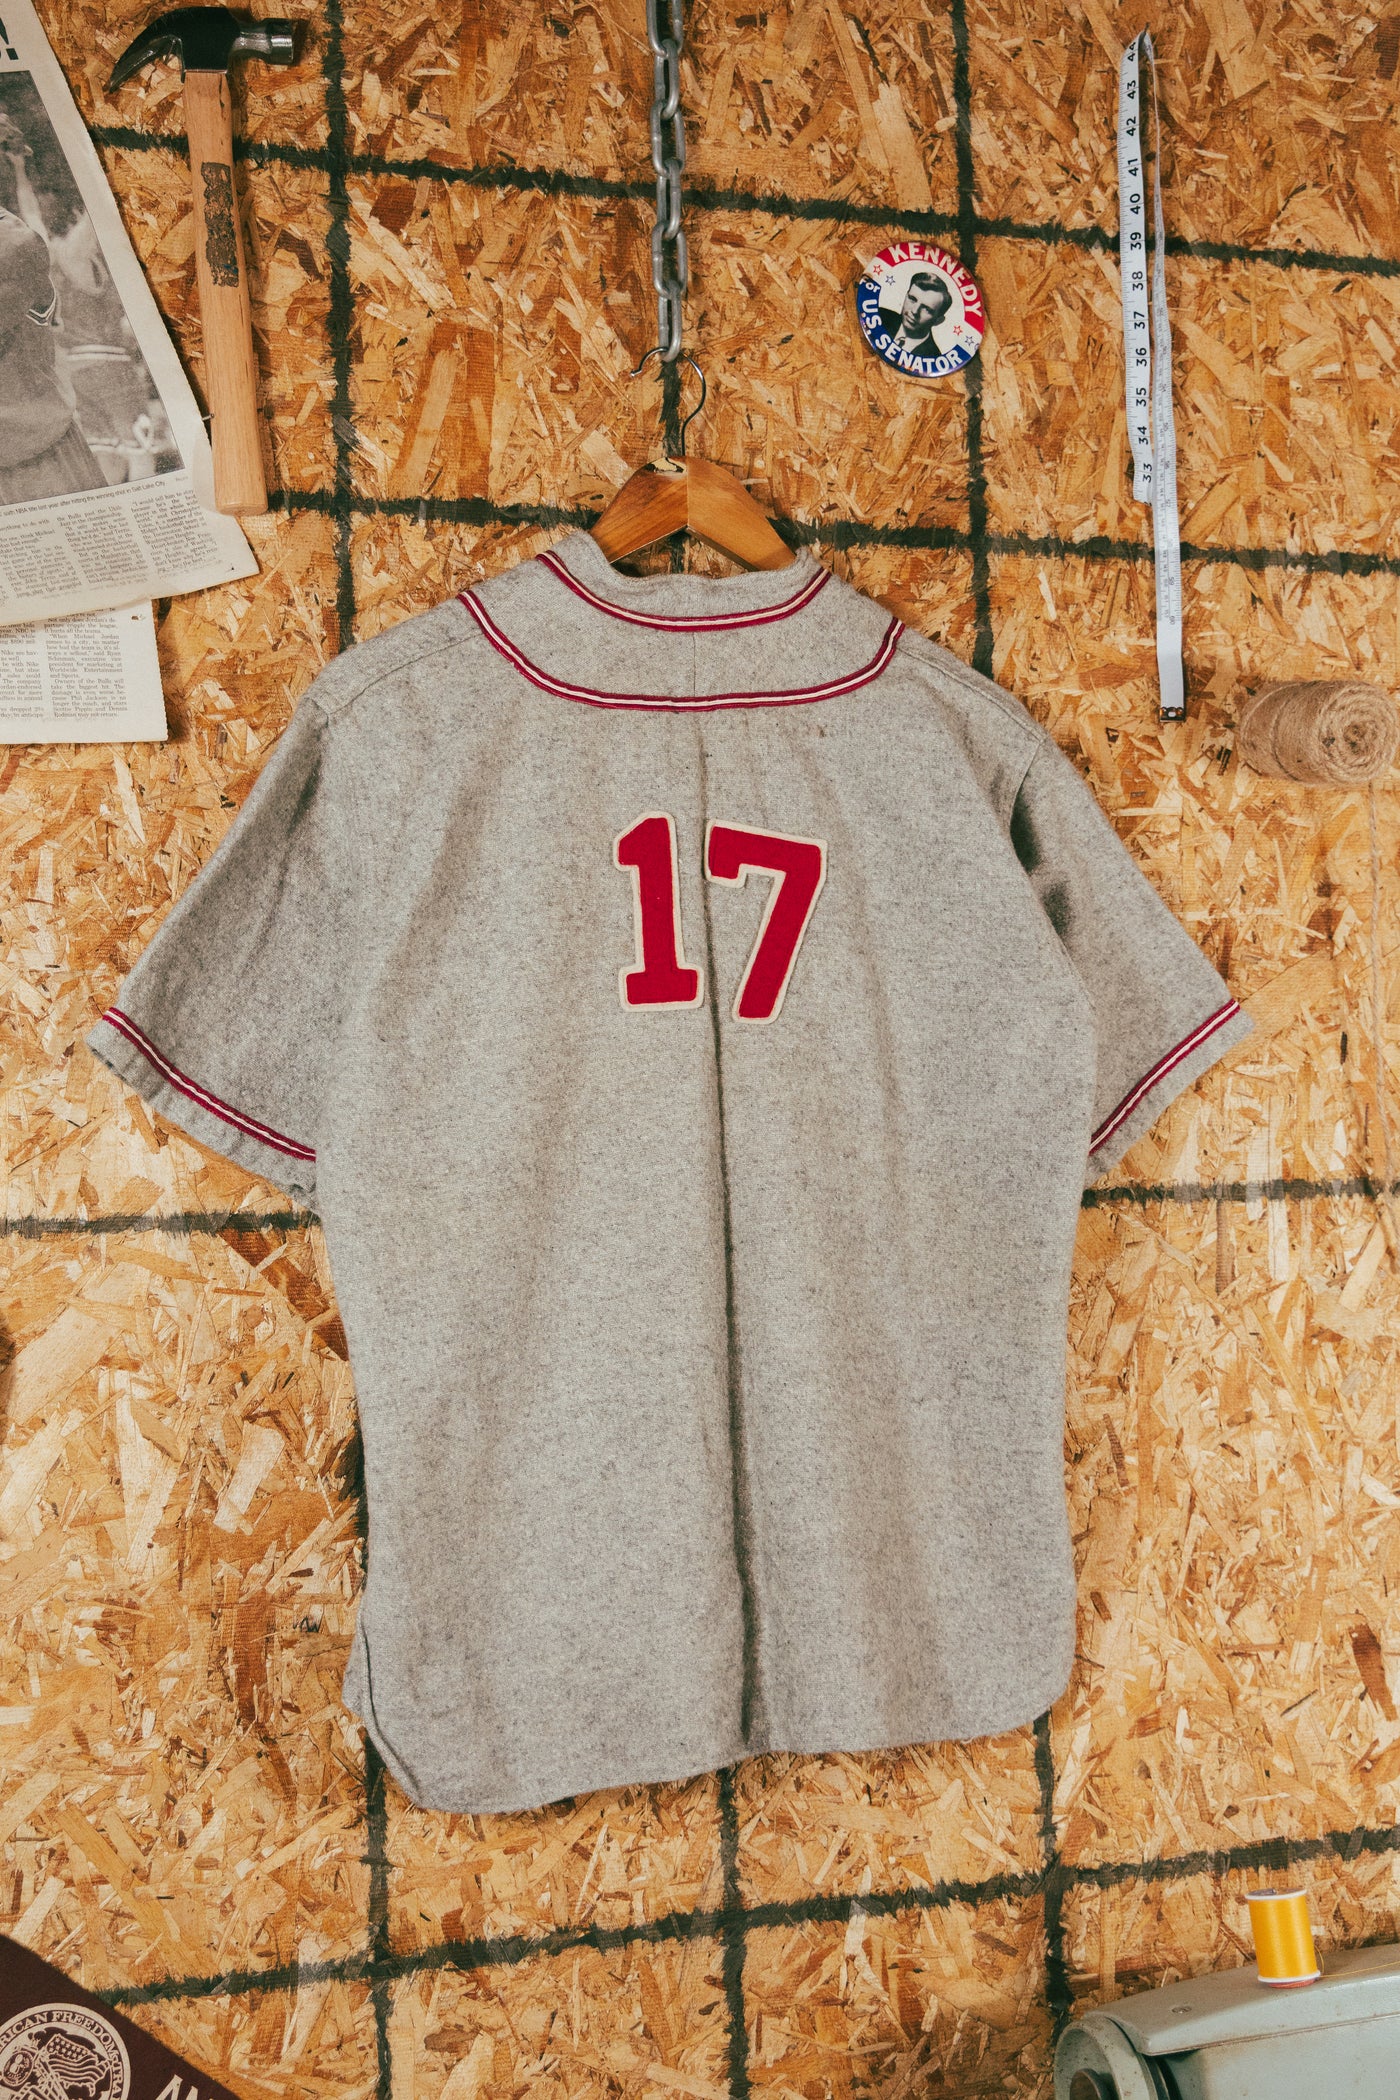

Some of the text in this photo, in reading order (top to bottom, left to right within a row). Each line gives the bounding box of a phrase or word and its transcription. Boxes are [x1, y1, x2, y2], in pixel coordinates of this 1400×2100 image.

[1126, 79, 1137, 99] 43
[1126, 115, 1137, 137] 42
[1128, 158, 1139, 177] 41
[1129, 193, 1141, 214] 40
[1130, 232, 1142, 251] 39
[887, 241, 983, 317] KENNEDY
[1132, 270, 1144, 291] 38
[1134, 311, 1146, 329] 37
[861, 298, 882, 336] U.S.
[875, 333, 963, 374] SENATOR
[1136, 347, 1148, 367] 36
[1136, 387, 1148, 407] 35
[1138, 426, 1149, 445] 34
[1142, 463, 1153, 483] 33
[48, 502, 59, 510] year
[71, 497, 87, 505] hitting
[96, 491, 115, 499] winning
[171, 506, 200, 516] Christopher
[160, 522, 184, 530] basketball
[611, 810, 830, 1025] 17
[51, 2010, 120, 2058] FREEDOM
